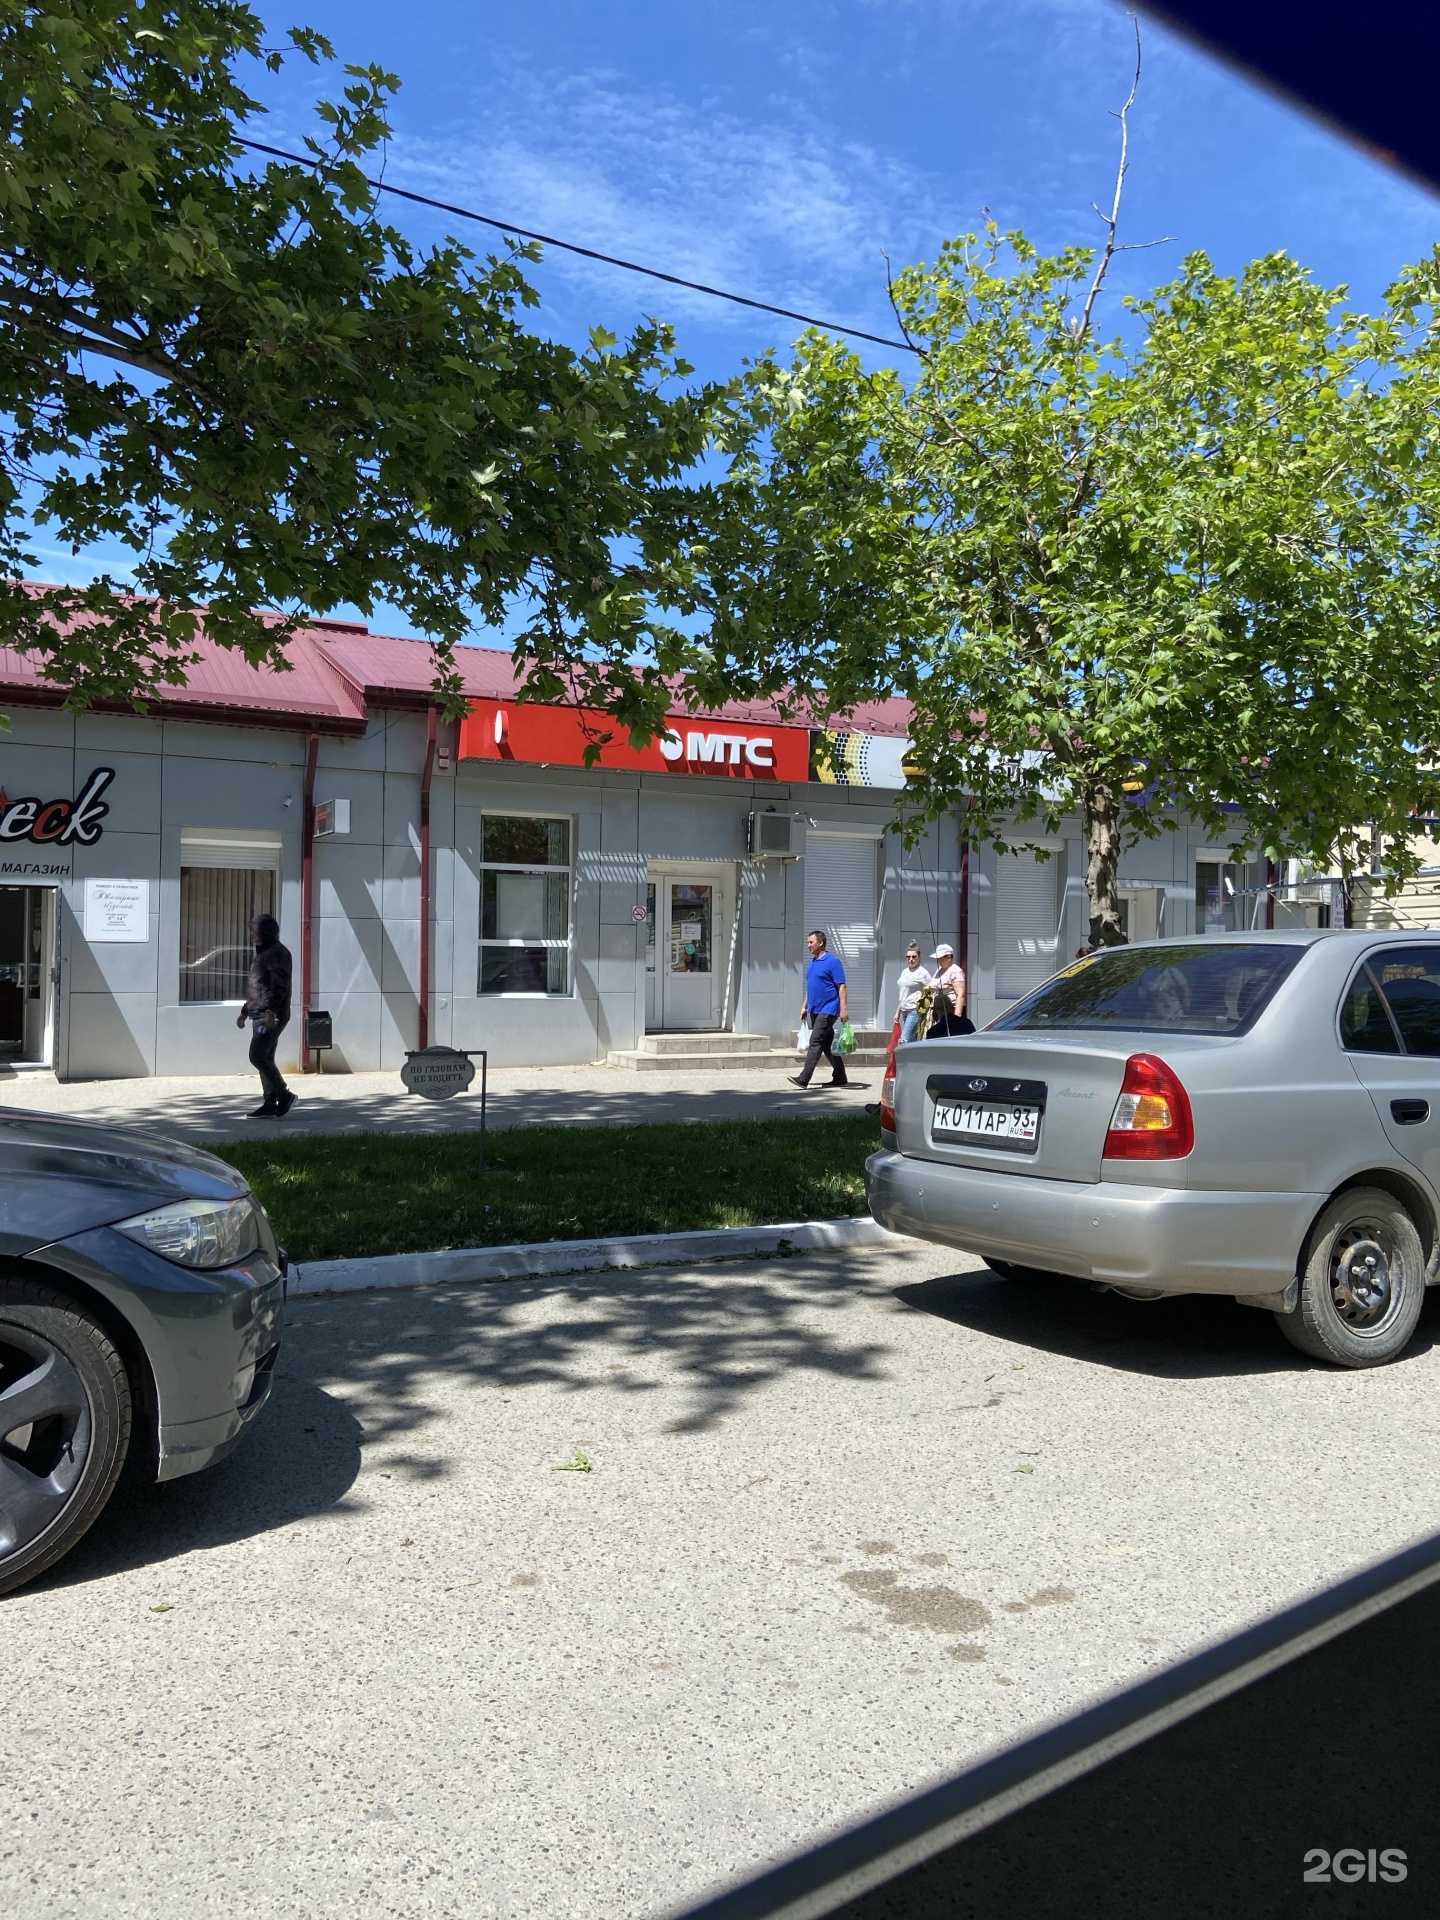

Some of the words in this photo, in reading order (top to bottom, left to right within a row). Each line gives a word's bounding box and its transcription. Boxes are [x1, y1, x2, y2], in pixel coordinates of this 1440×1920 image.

[687, 731, 773, 767] МТС
[1, 863, 71, 875] МАГАЗИН
[410, 1065, 423, 1074] ПО
[425, 1063, 467, 1074] ГАЗОНАМ
[414, 1075, 426, 1083] НЕ
[428, 1073, 464, 1082] ХОДИТЬ
[1012, 1108, 1031, 1127] 93
[1009, 1126, 1024, 1136] RUS
